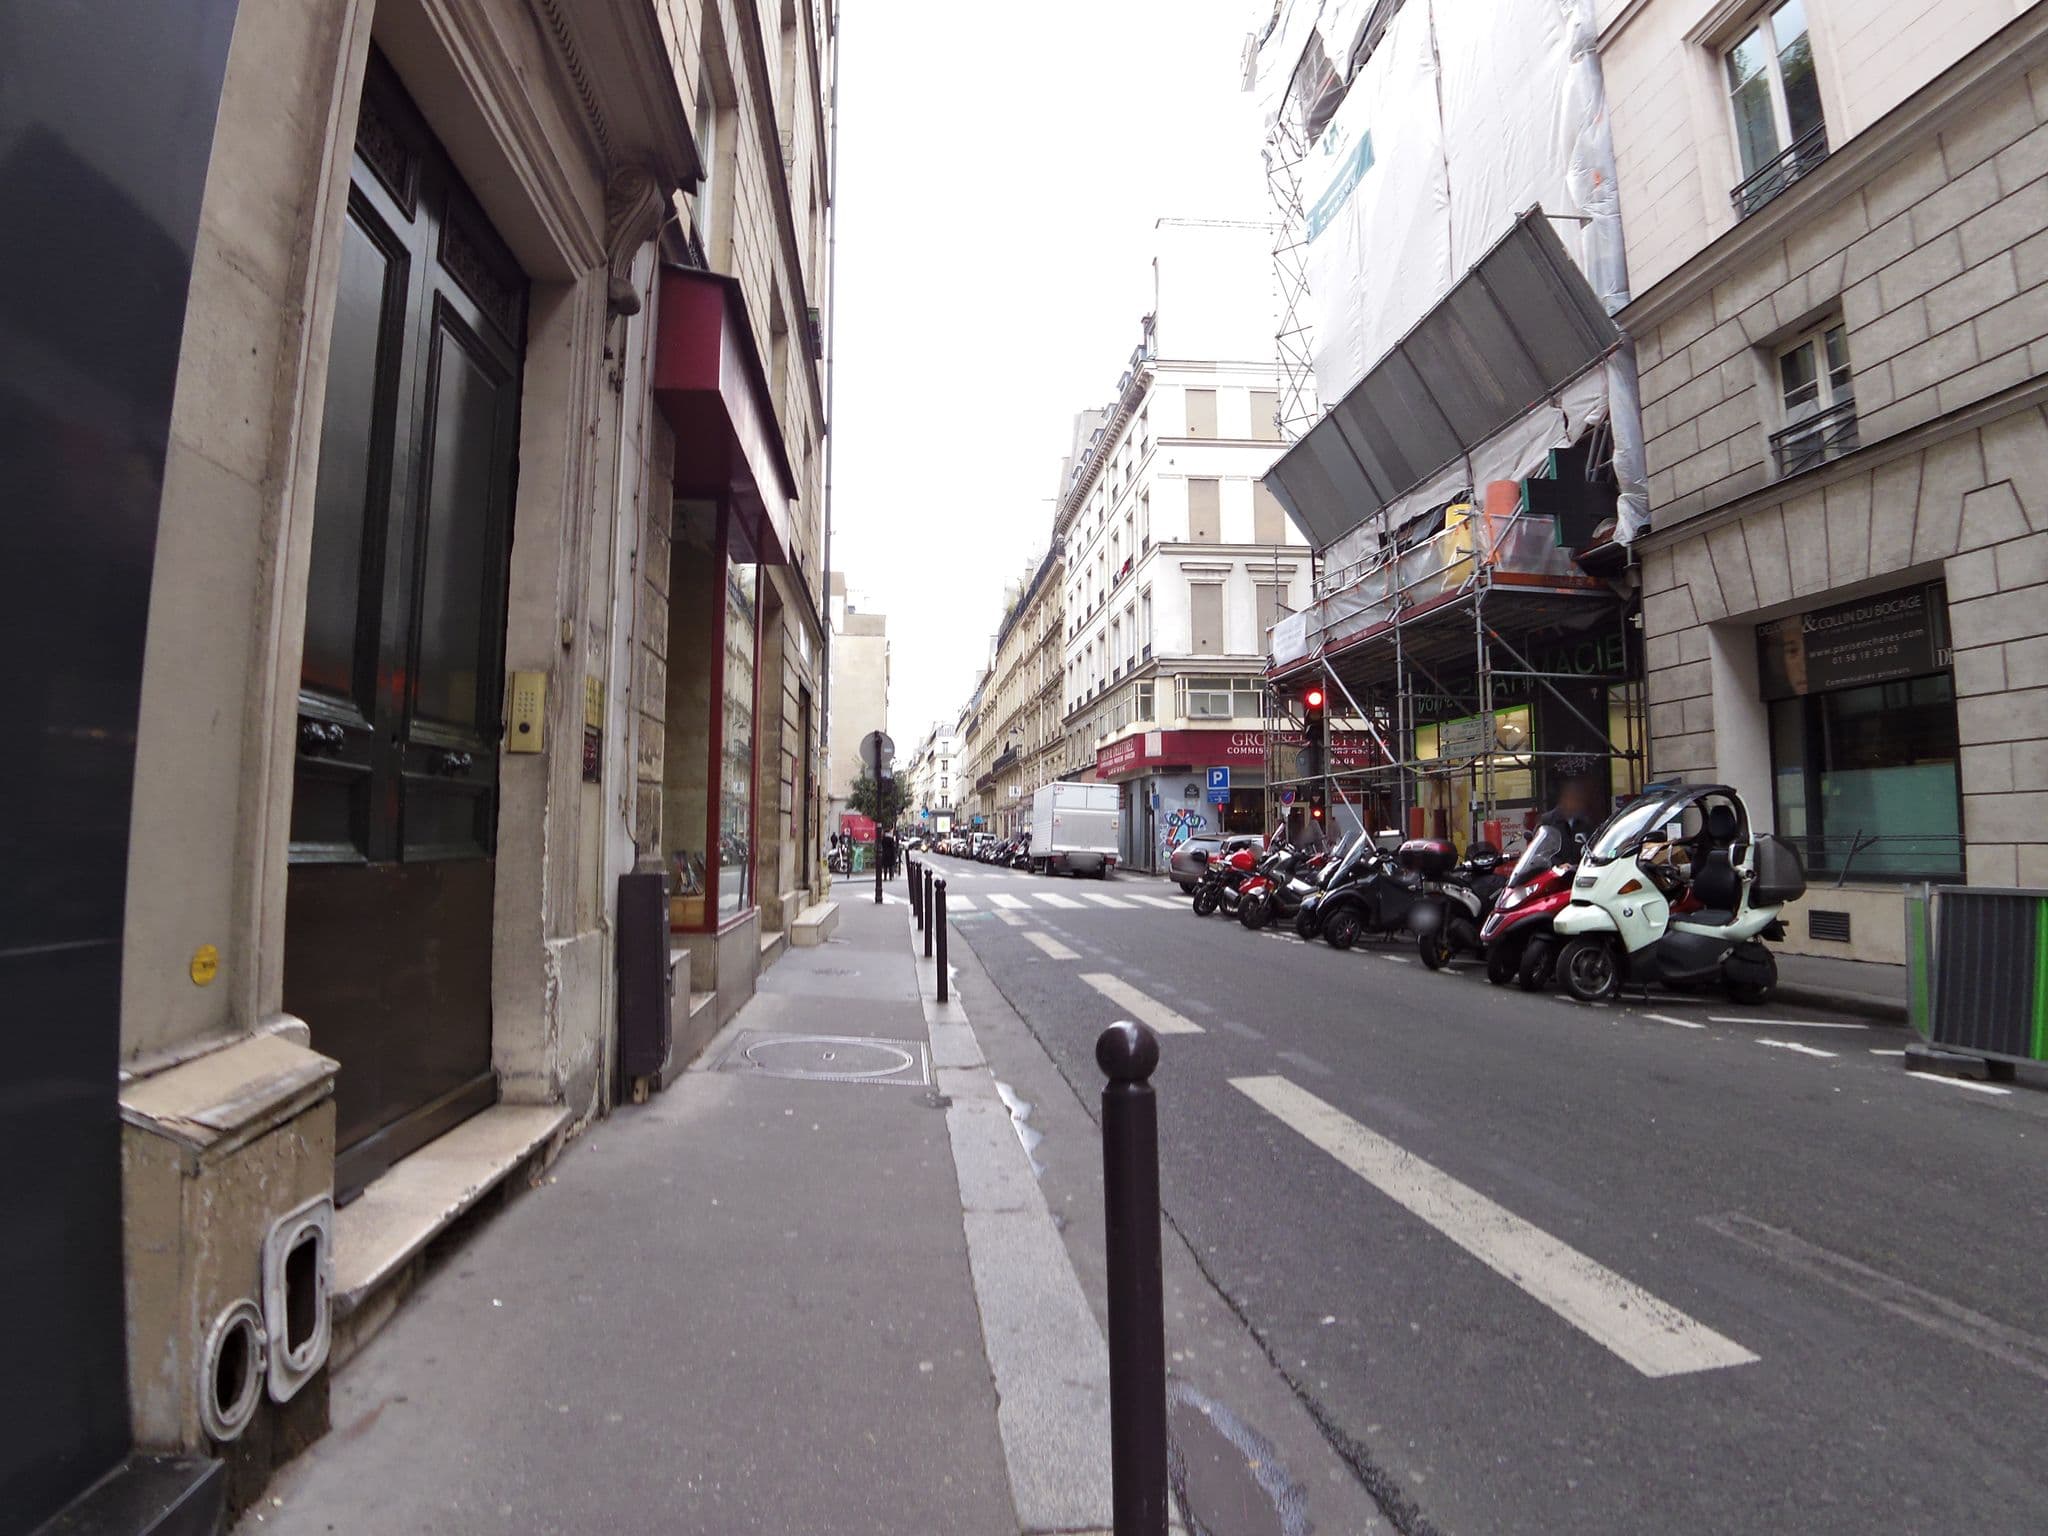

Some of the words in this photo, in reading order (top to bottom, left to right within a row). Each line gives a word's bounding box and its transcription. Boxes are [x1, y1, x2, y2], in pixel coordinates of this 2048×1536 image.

[1803, 613, 1817, 633] &
[1818, 611, 1855, 630] COLLIN
[1856, 607, 1873, 620] DU
[1875, 595, 1921, 615] BOCAGE
[1456, 631, 1624, 697] PARMACIE
[1213, 771, 1223, 785] P
